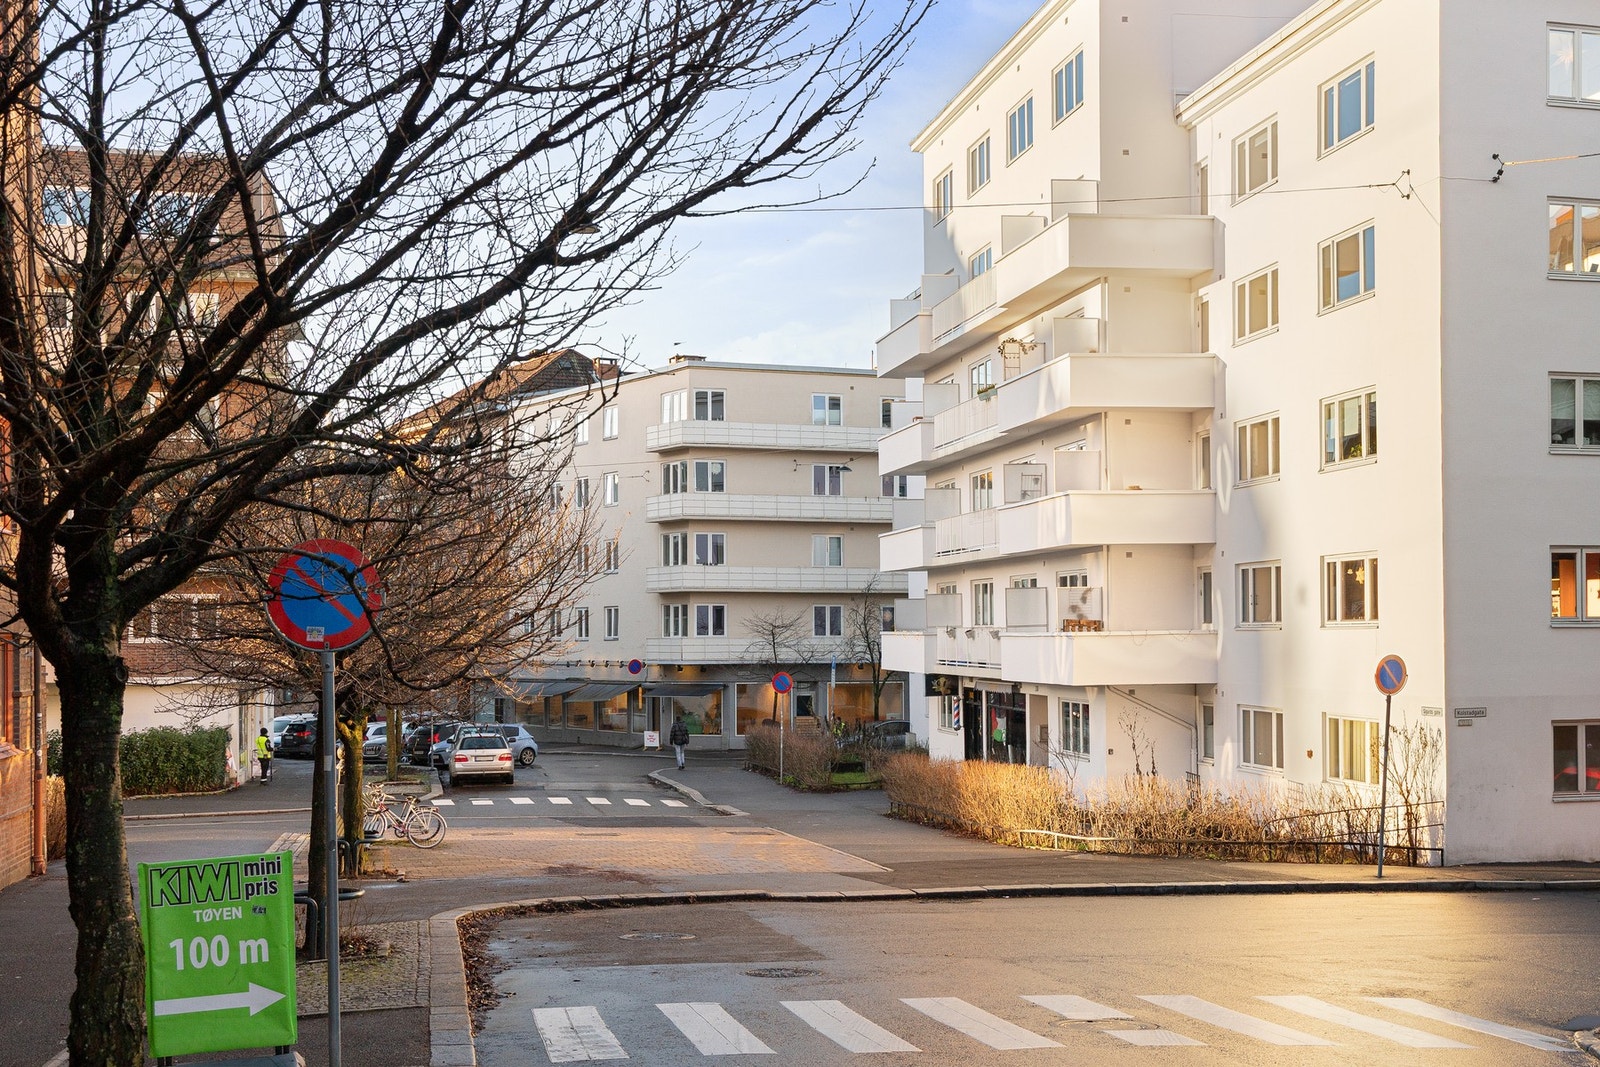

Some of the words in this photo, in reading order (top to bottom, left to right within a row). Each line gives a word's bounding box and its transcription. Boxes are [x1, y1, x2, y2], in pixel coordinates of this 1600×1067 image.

[150, 861, 241, 907] KIWI
[244, 856, 282, 877] mini
[244, 877, 278, 900] pris
[193, 907, 242, 923] TØYEN
[169, 934, 230, 971] 100
[239, 937, 269, 965] m
